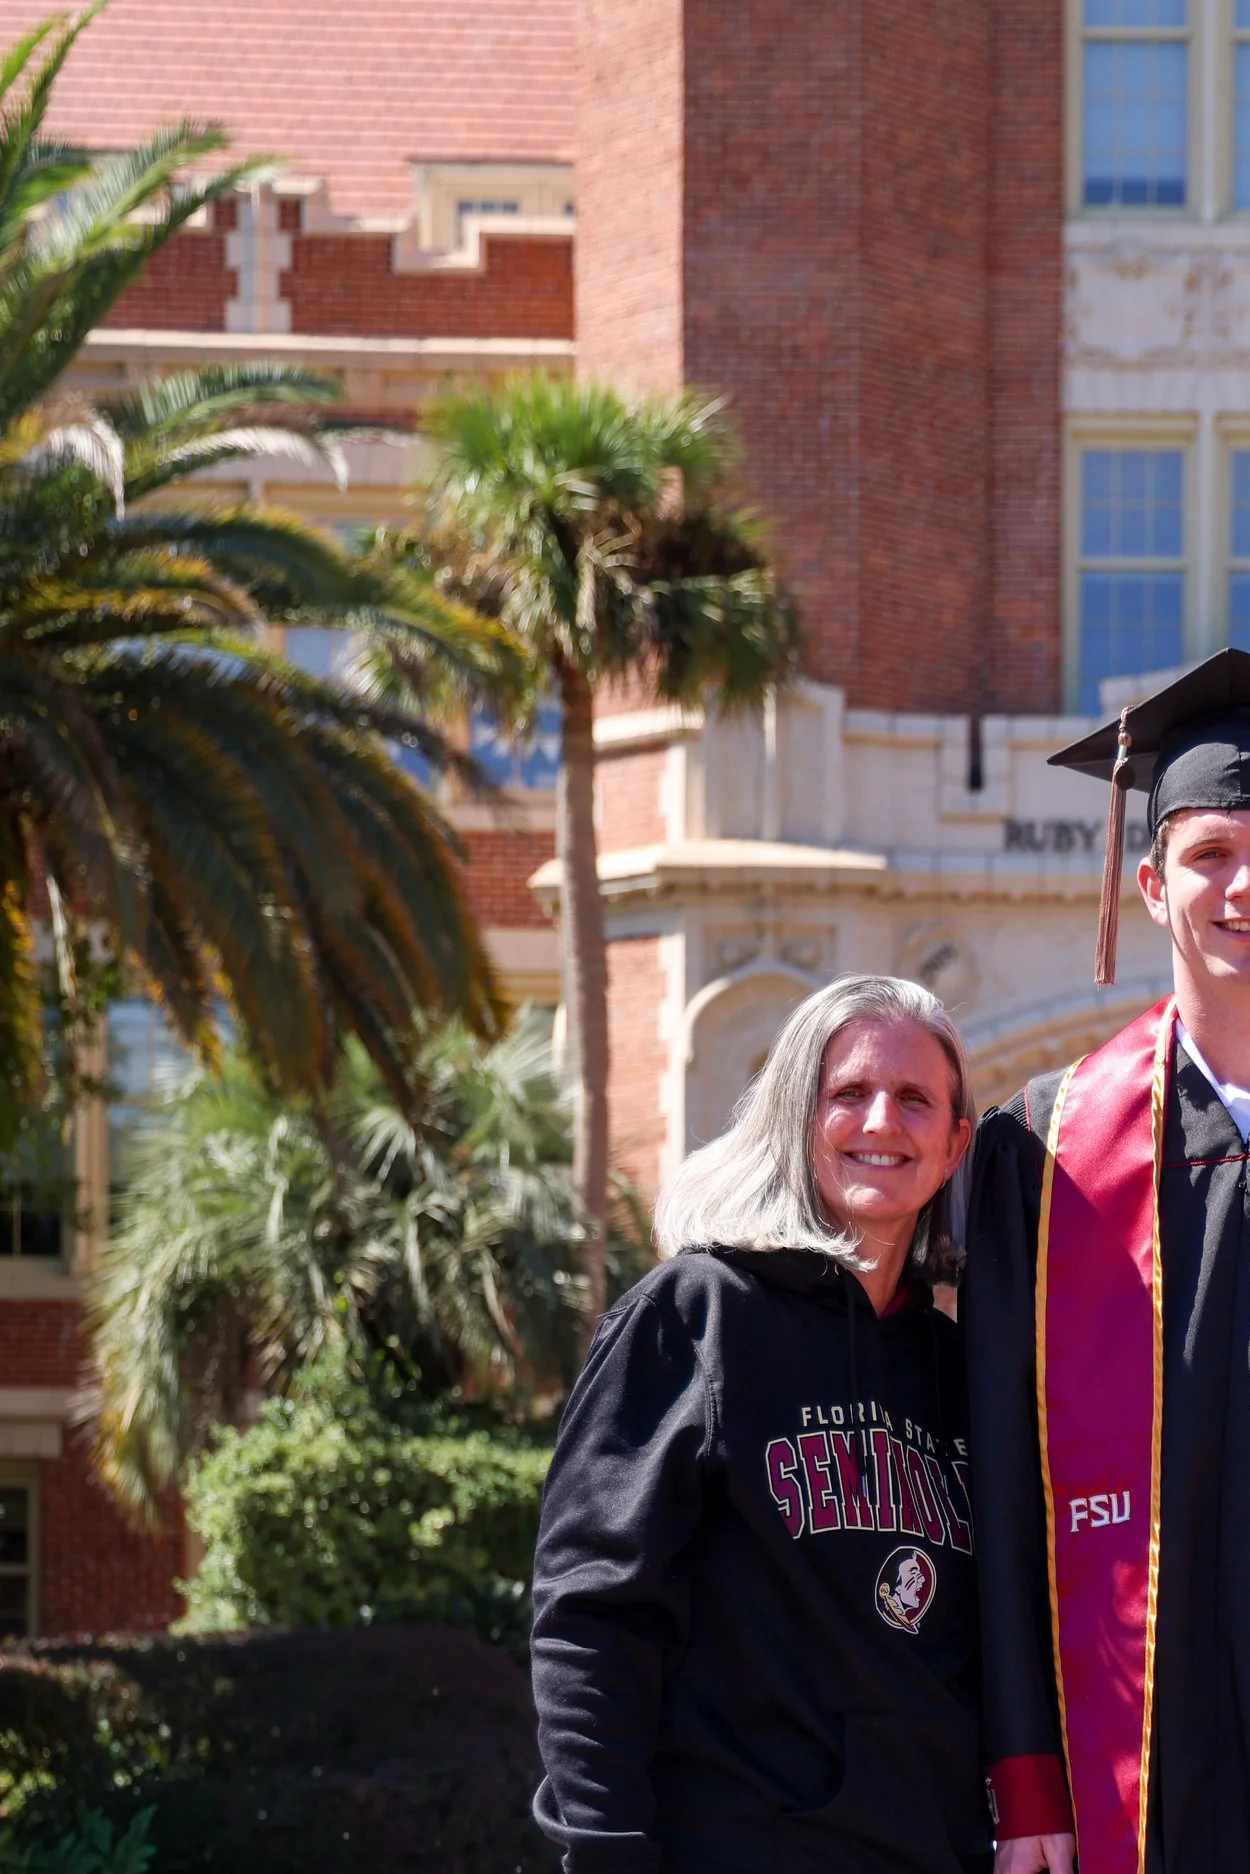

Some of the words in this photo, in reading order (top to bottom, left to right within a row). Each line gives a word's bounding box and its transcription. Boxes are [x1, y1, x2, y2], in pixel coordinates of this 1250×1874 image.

[1004, 820, 1104, 853] RUBY
[905, 1418, 969, 1457] STAE
[765, 1427, 975, 1557] SEMINOL
[1068, 1490, 1131, 1533] FSU
